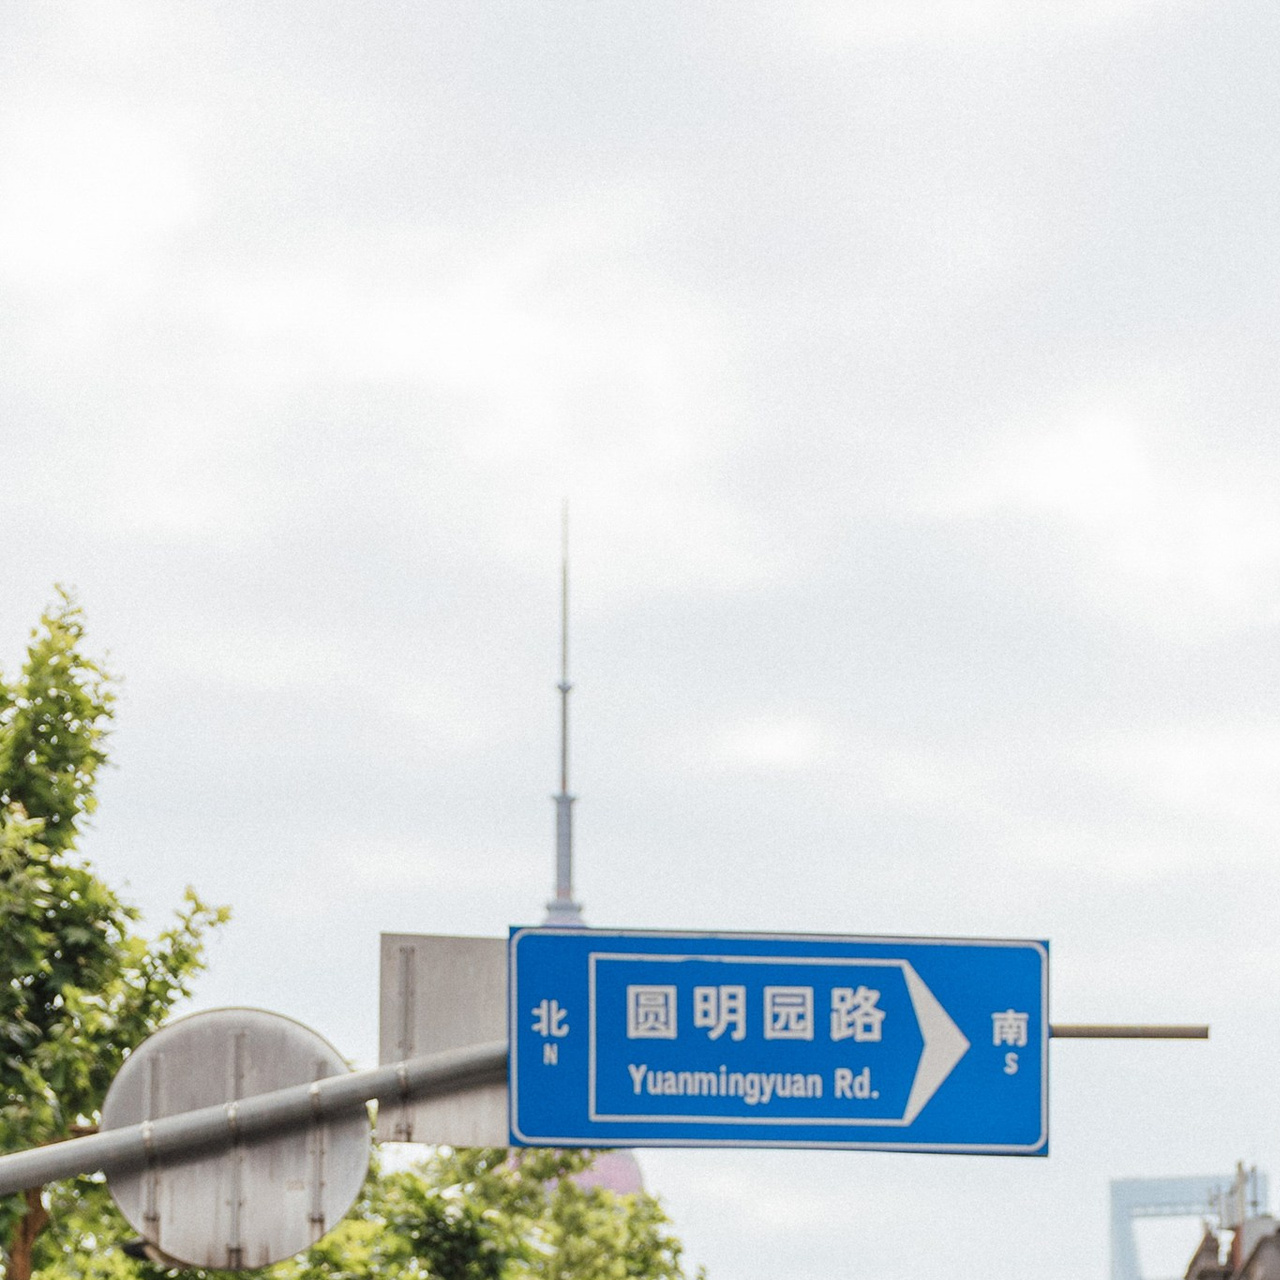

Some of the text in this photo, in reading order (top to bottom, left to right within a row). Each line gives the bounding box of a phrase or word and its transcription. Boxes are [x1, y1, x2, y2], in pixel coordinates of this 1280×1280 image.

[532, 999, 569, 1037] 北
[626, 984, 886, 1042] 圆明园路
[992, 1009, 1029, 1047] 南
[543, 1043, 558, 1065] N
[1004, 1052, 1018, 1075] S
[628, 1064, 879, 1105] Yuanmingyuan Rd.
